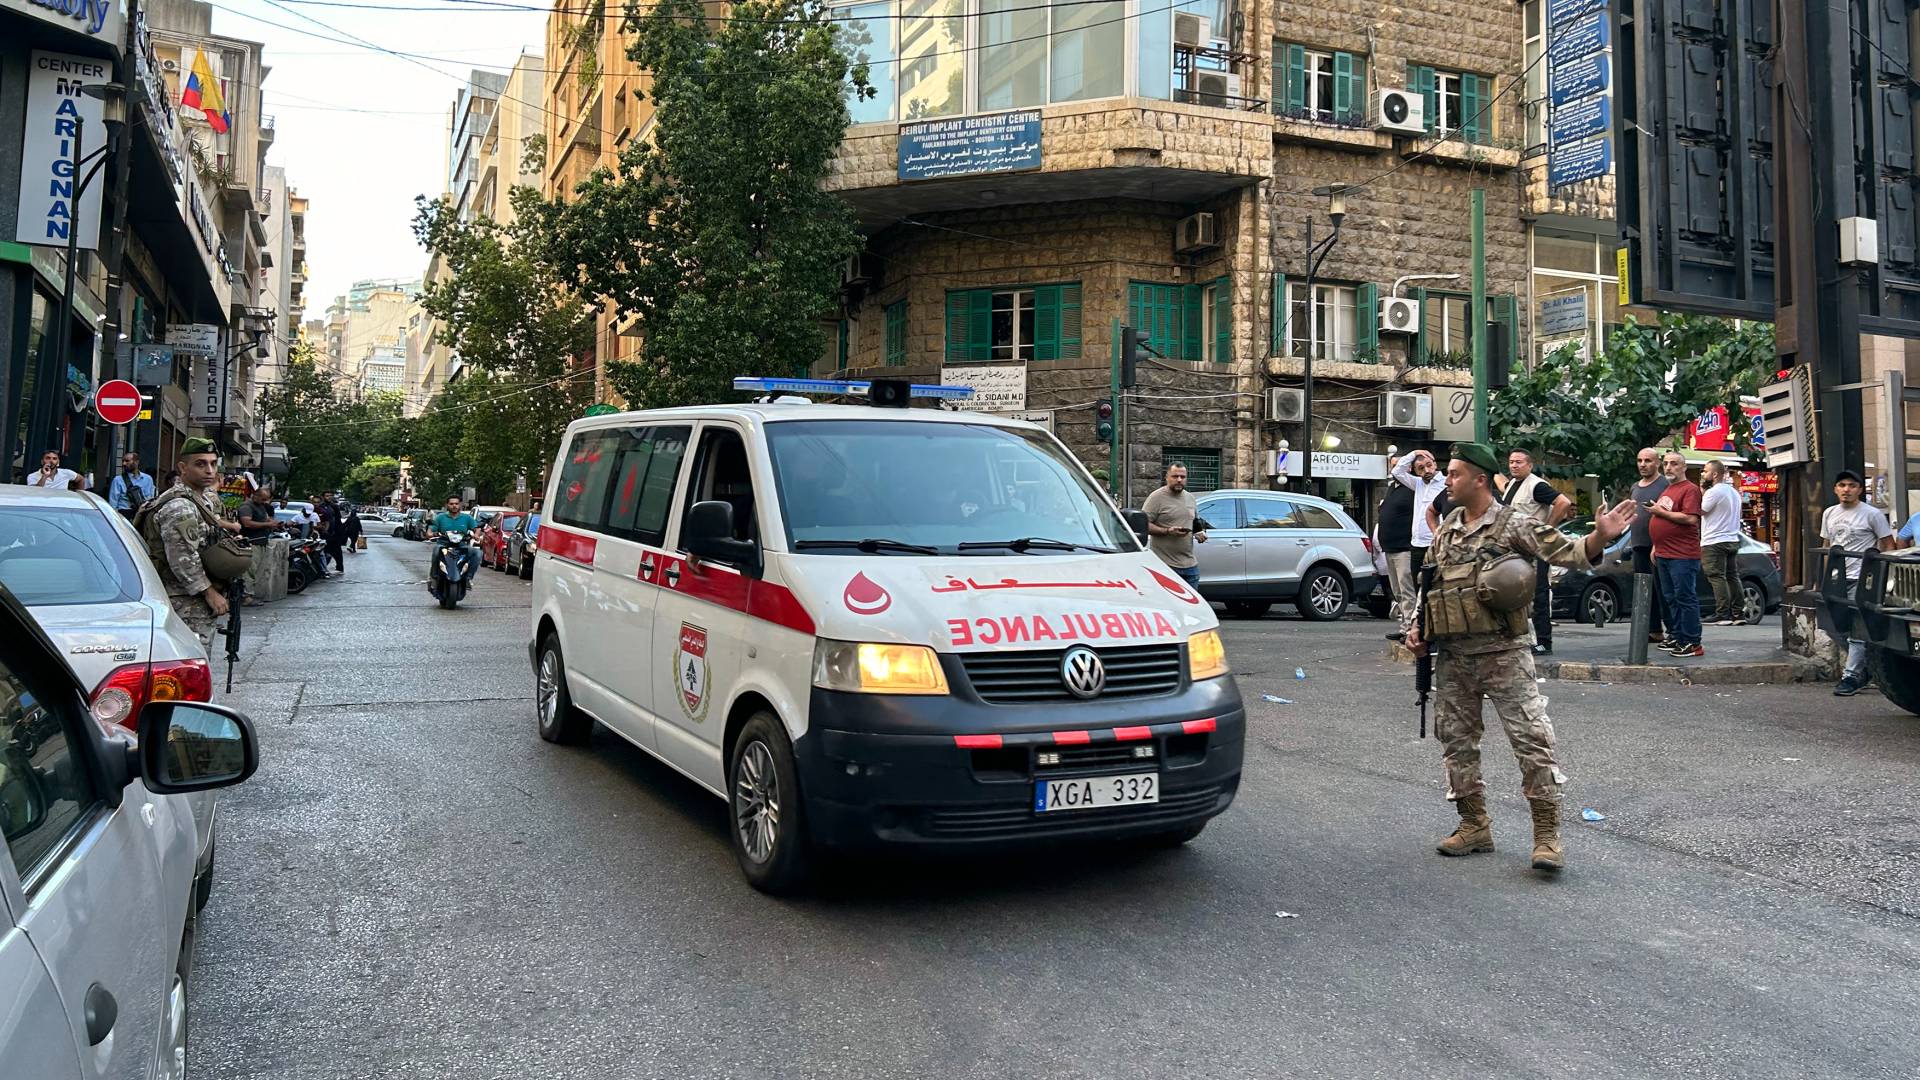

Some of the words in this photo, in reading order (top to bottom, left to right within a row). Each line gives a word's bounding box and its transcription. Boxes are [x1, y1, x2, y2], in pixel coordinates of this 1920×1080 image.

[37, 57, 104, 78] CENTER
[901, 124, 927, 136] BEIRUT
[929, 120, 963, 133] IMPLANT
[965, 115, 1007, 129] DENTISTRY
[1008, 112, 1040, 124] CENTRE
[957, 130, 978, 138] IMPLANT
[979, 127, 1005, 136] DENTISTRY
[1006, 125, 1025, 133] CENTRE
[947, 138, 969, 146] HOSPITAL
[1010, 142, 1039, 152] مركز
[940, 149, 970, 161] لغرس
[973, 146, 1006, 156] بيروت
[46, 78, 82, 240] MARIGNAN
[1563, 295, 1584, 305] Khalil
[208, 358, 217, 413] EEKEND
[1313, 455, 1360, 465] ARFOUSH
[930, 574, 1144, 595] إسعاف
[70, 644, 138, 654] COROLLA
[1050, 780, 1093, 808] XGA
[1112, 776, 1154, 801] 332
